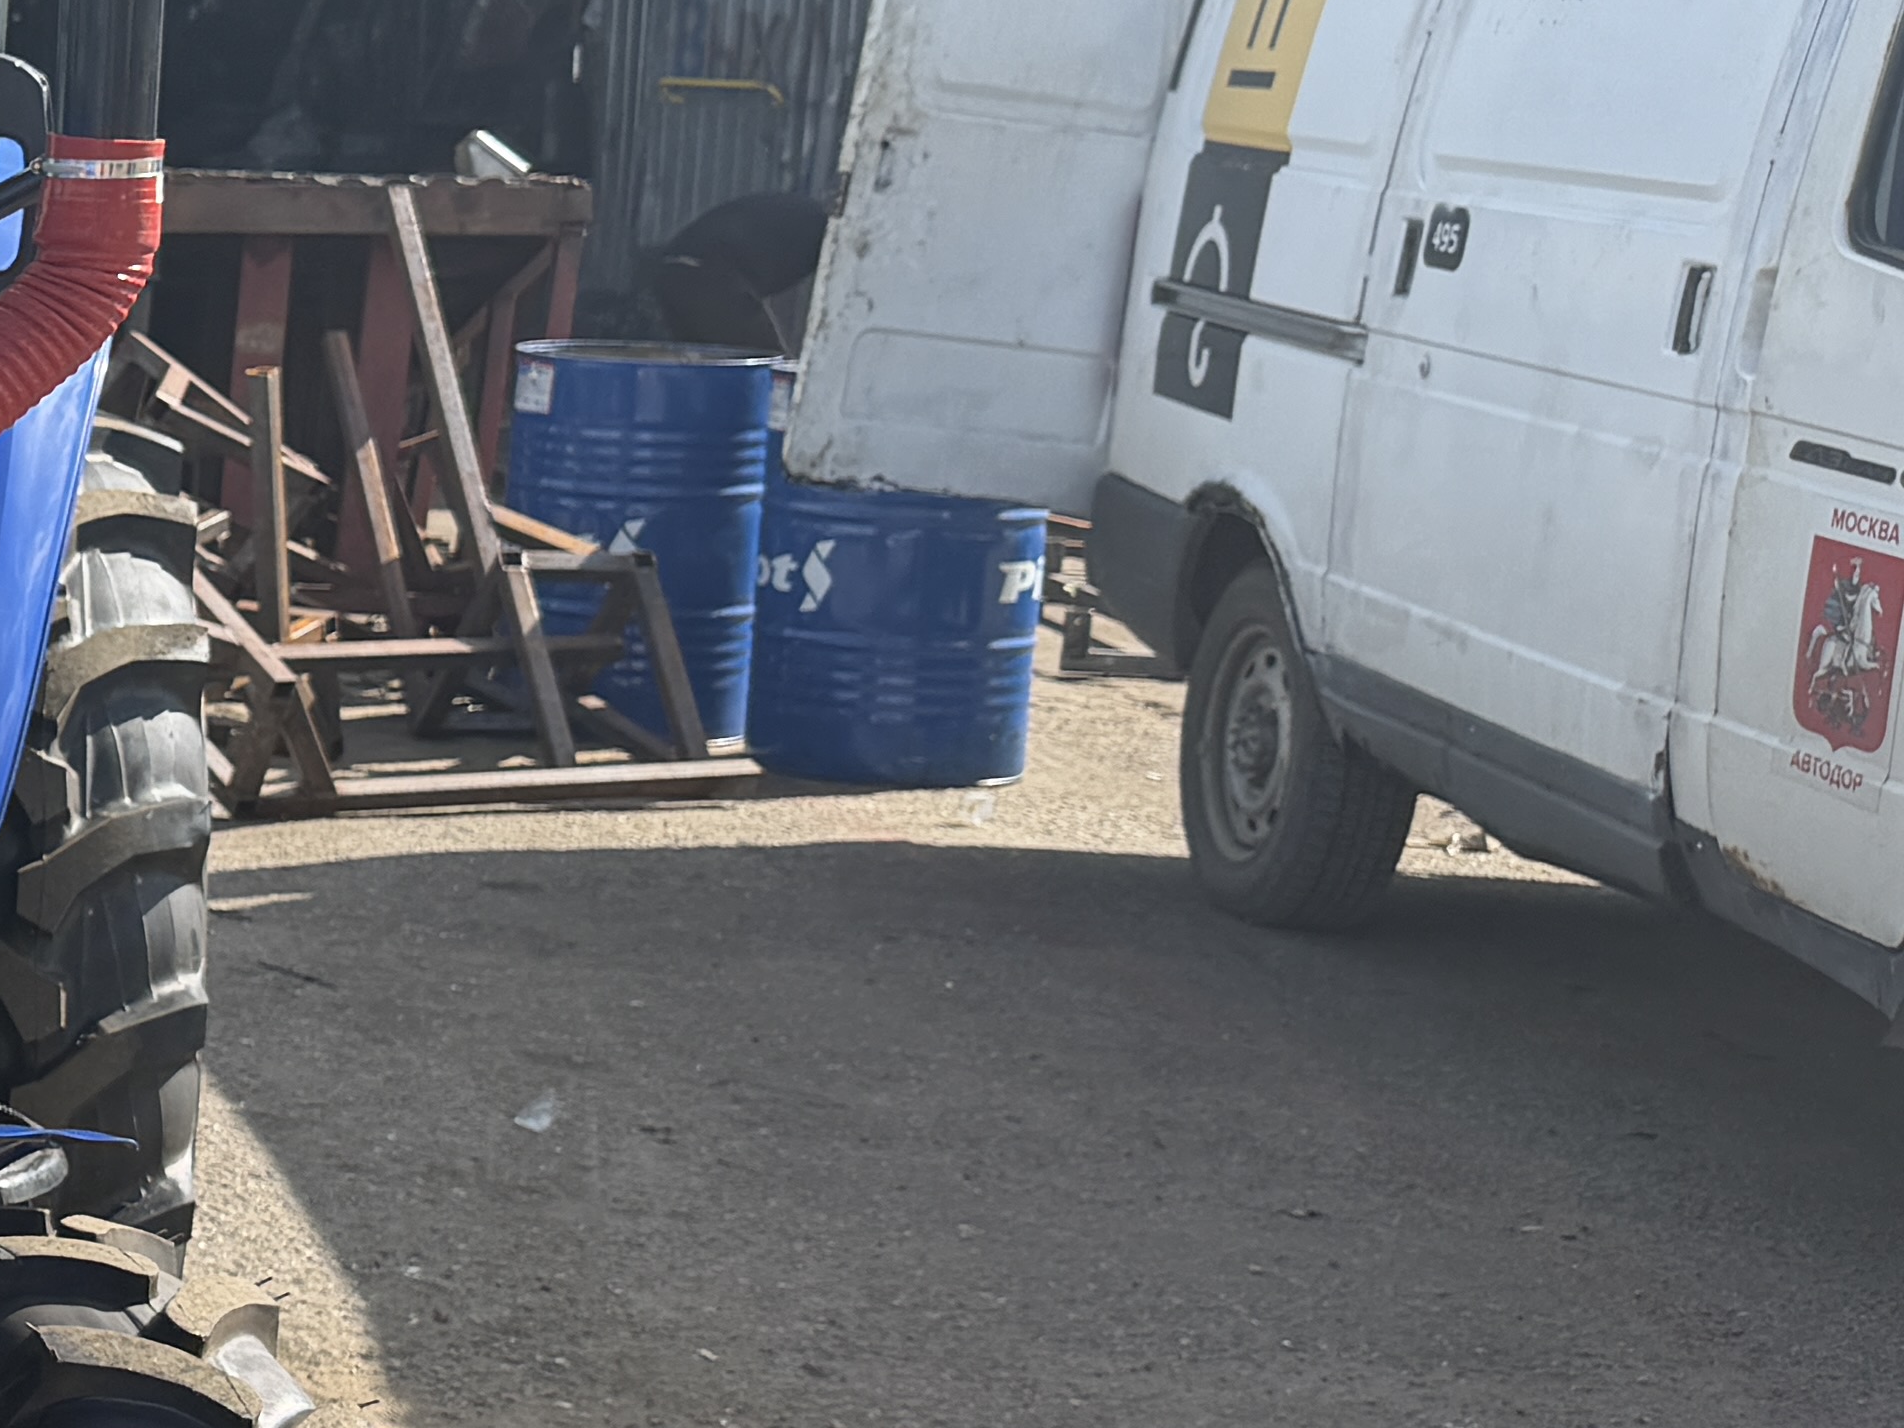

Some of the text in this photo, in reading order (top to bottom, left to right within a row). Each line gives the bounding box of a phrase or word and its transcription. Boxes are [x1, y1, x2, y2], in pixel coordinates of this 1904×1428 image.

[1431, 219, 1461, 254] 495
[1830, 507, 1900, 546] МОСКВА
[1789, 749, 1864, 793] АВТОДОР
